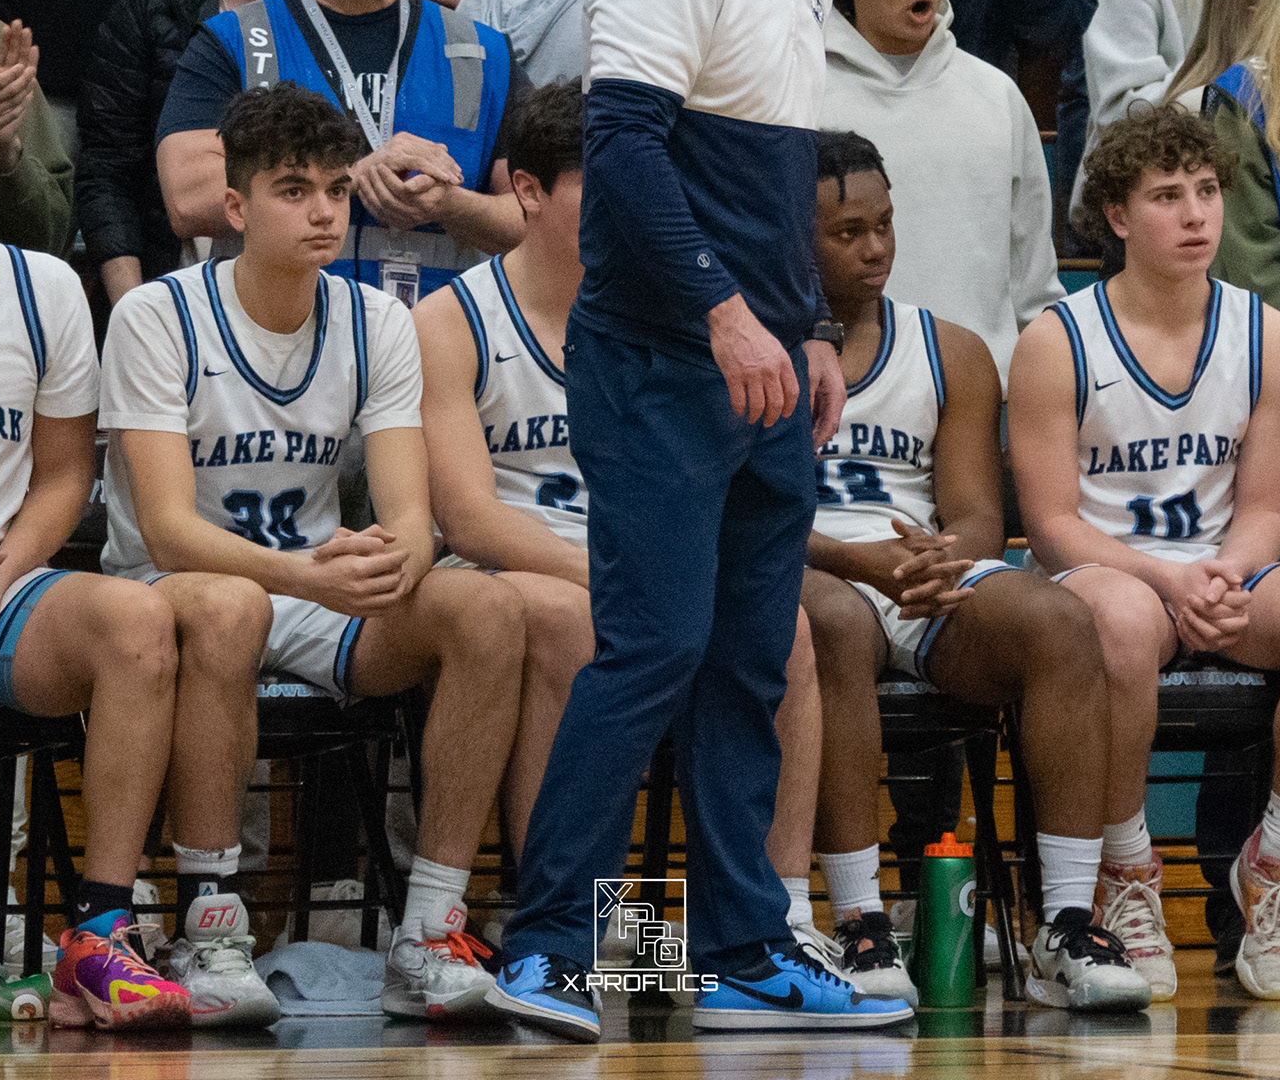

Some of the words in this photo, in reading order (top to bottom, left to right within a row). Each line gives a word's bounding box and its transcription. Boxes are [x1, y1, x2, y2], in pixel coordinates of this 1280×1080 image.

[191, 430, 276, 468] LAKE
[483, 414, 568, 454] LAKE
[849, 423, 924, 469] PARK
[1087, 437, 1170, 476] LAKE
[1126, 488, 1203, 538] 10
